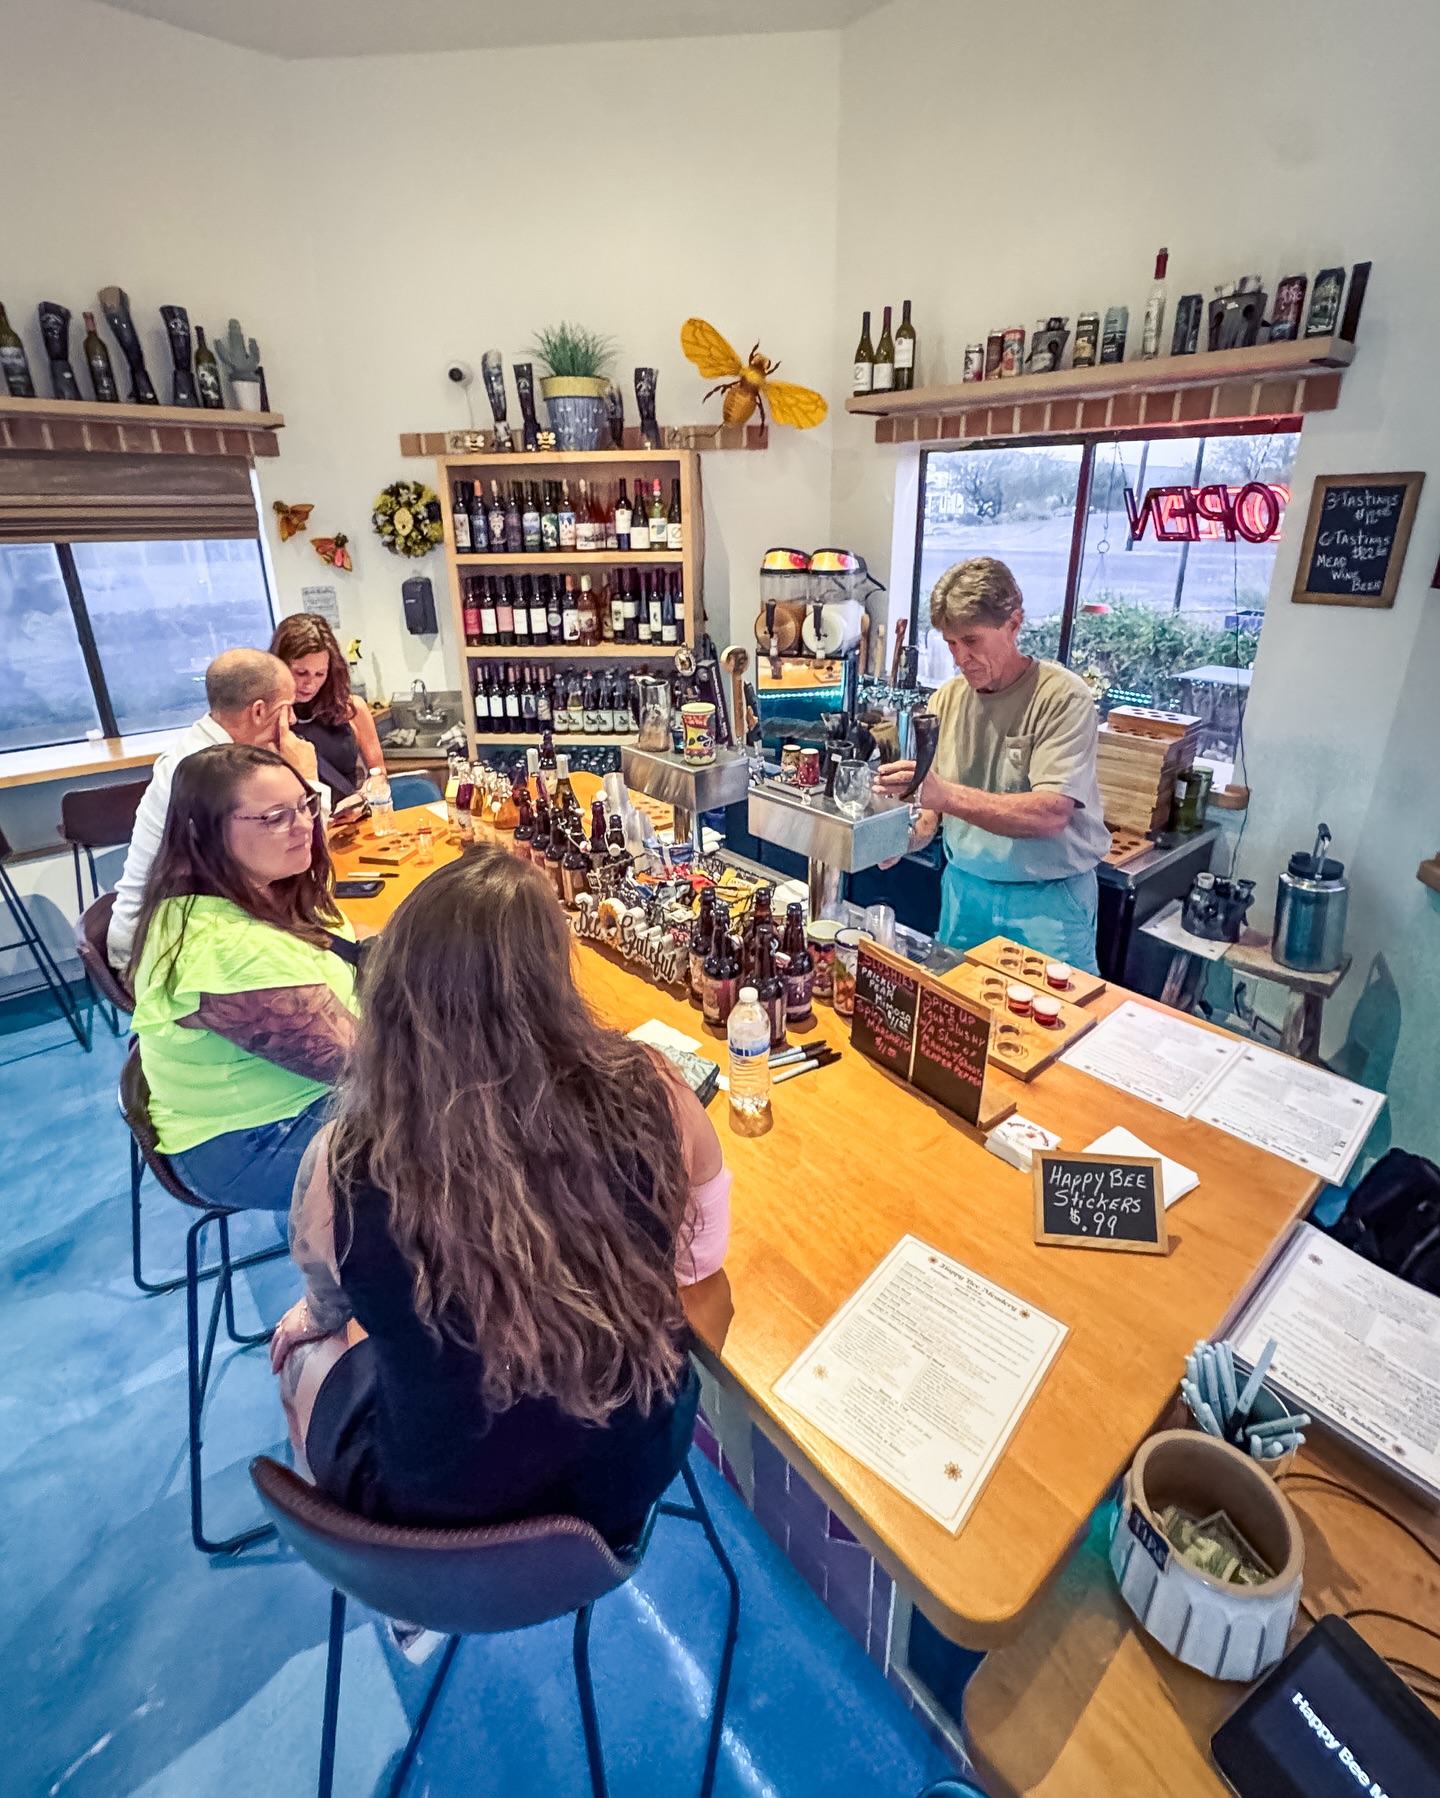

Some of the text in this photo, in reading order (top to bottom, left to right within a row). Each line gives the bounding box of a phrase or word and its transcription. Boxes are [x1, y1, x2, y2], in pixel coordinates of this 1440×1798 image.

[861, 966, 897, 992] PRICKLY
[1110, 1168, 1148, 1189] BEE
[1292, 1692, 1341, 1749] Happy
[1338, 1746, 1370, 1787] Bee
